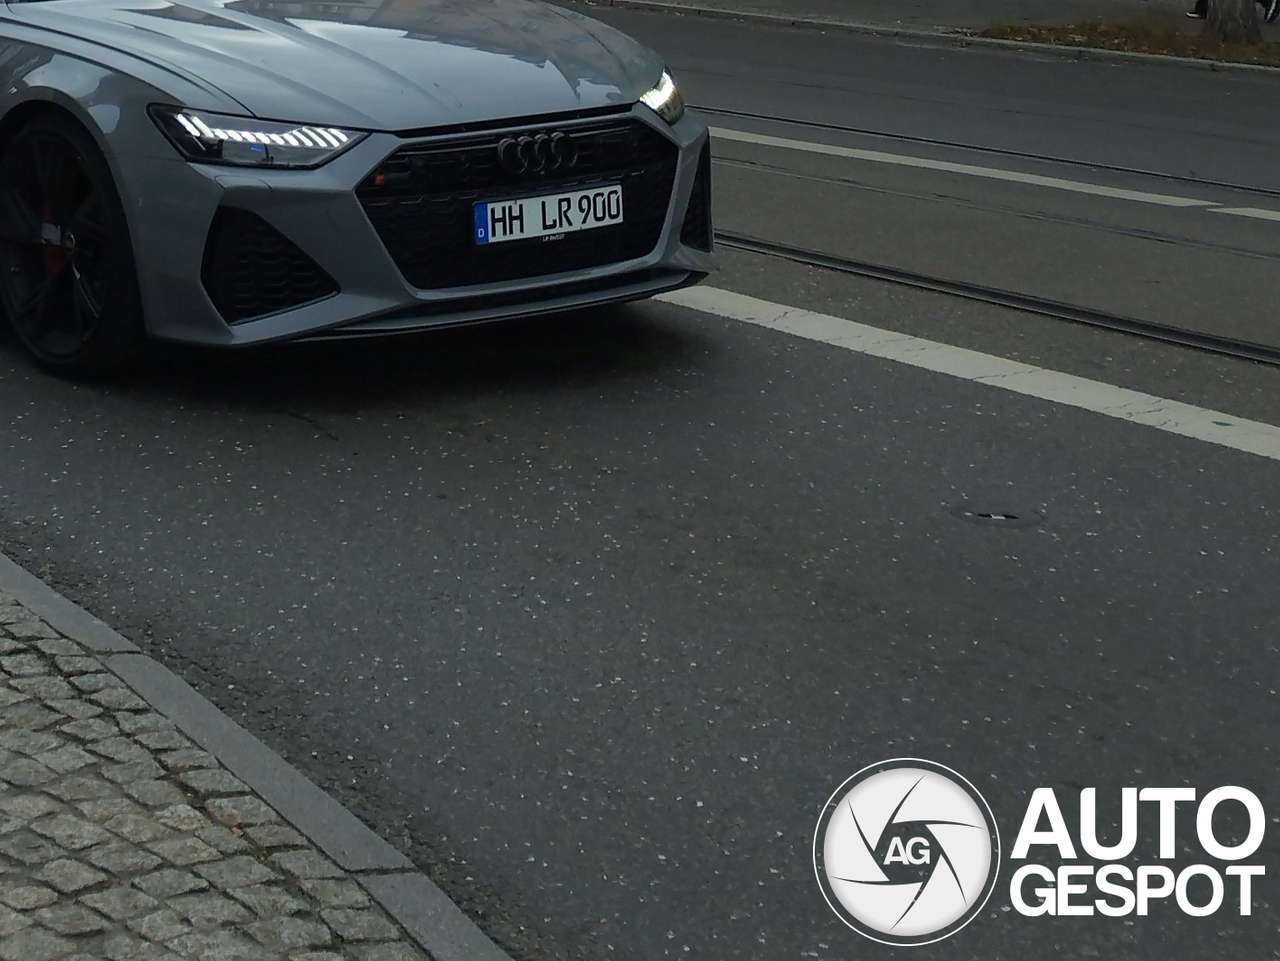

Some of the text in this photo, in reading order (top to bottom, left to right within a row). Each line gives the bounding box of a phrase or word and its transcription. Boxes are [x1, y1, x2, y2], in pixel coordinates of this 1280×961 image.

[490, 190, 621, 237] HH LR 900
